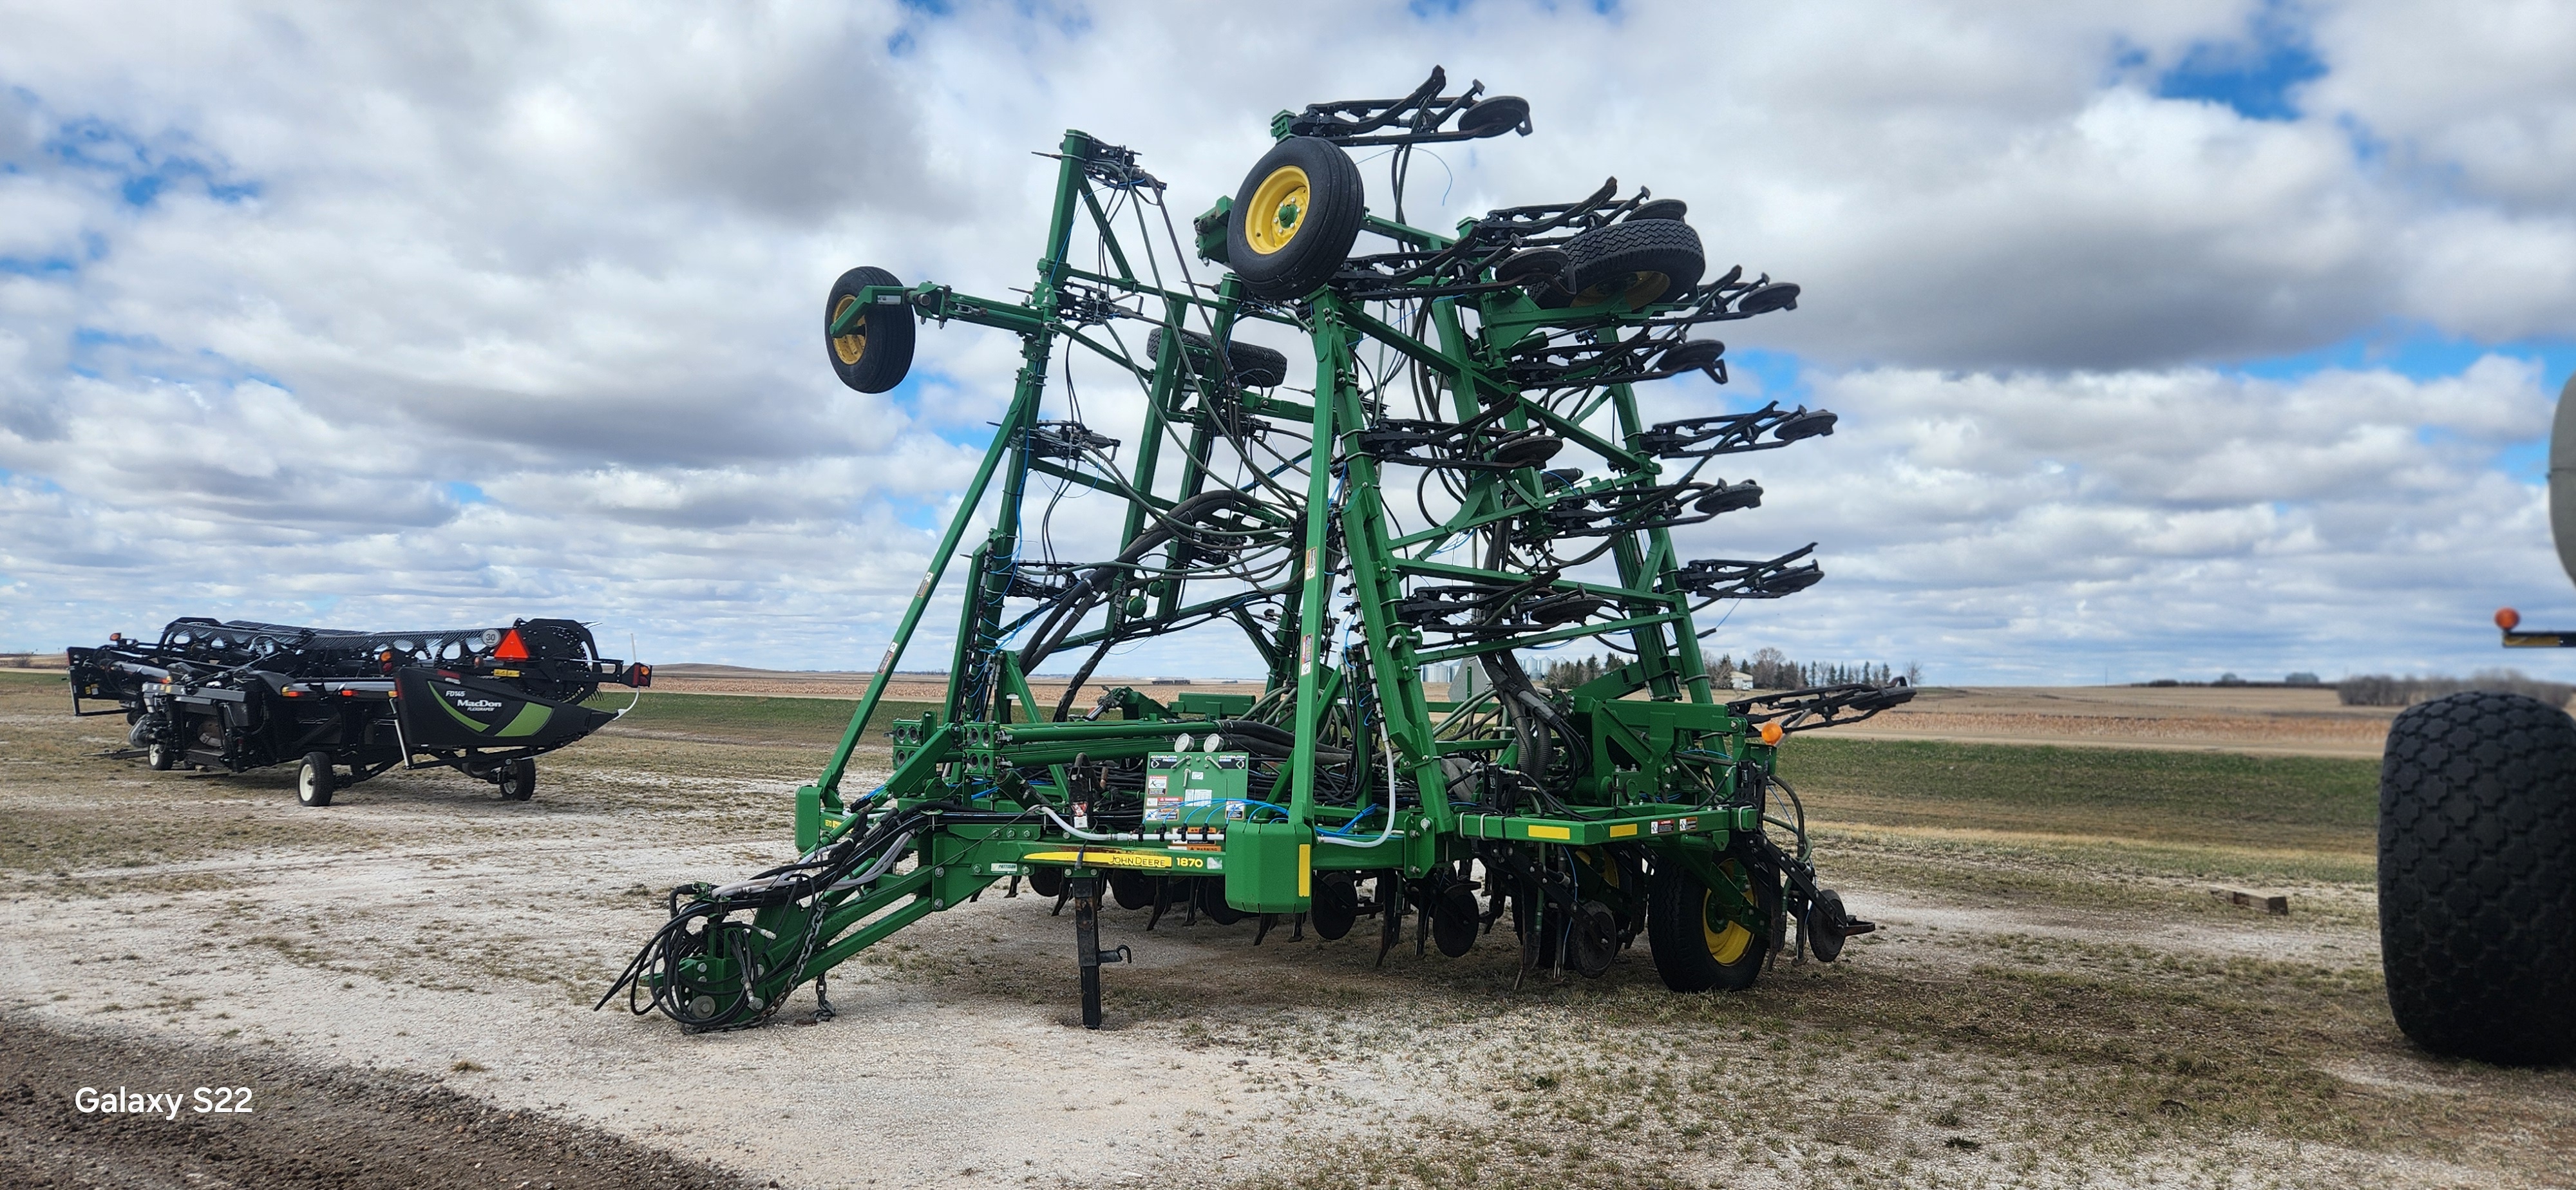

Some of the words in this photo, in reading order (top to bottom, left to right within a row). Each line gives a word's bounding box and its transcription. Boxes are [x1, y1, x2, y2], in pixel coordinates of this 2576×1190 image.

[1110, 855, 1133, 864] JOHN
[1135, 856, 1165, 866] DEERE
[1176, 857, 1203, 867] 1870
